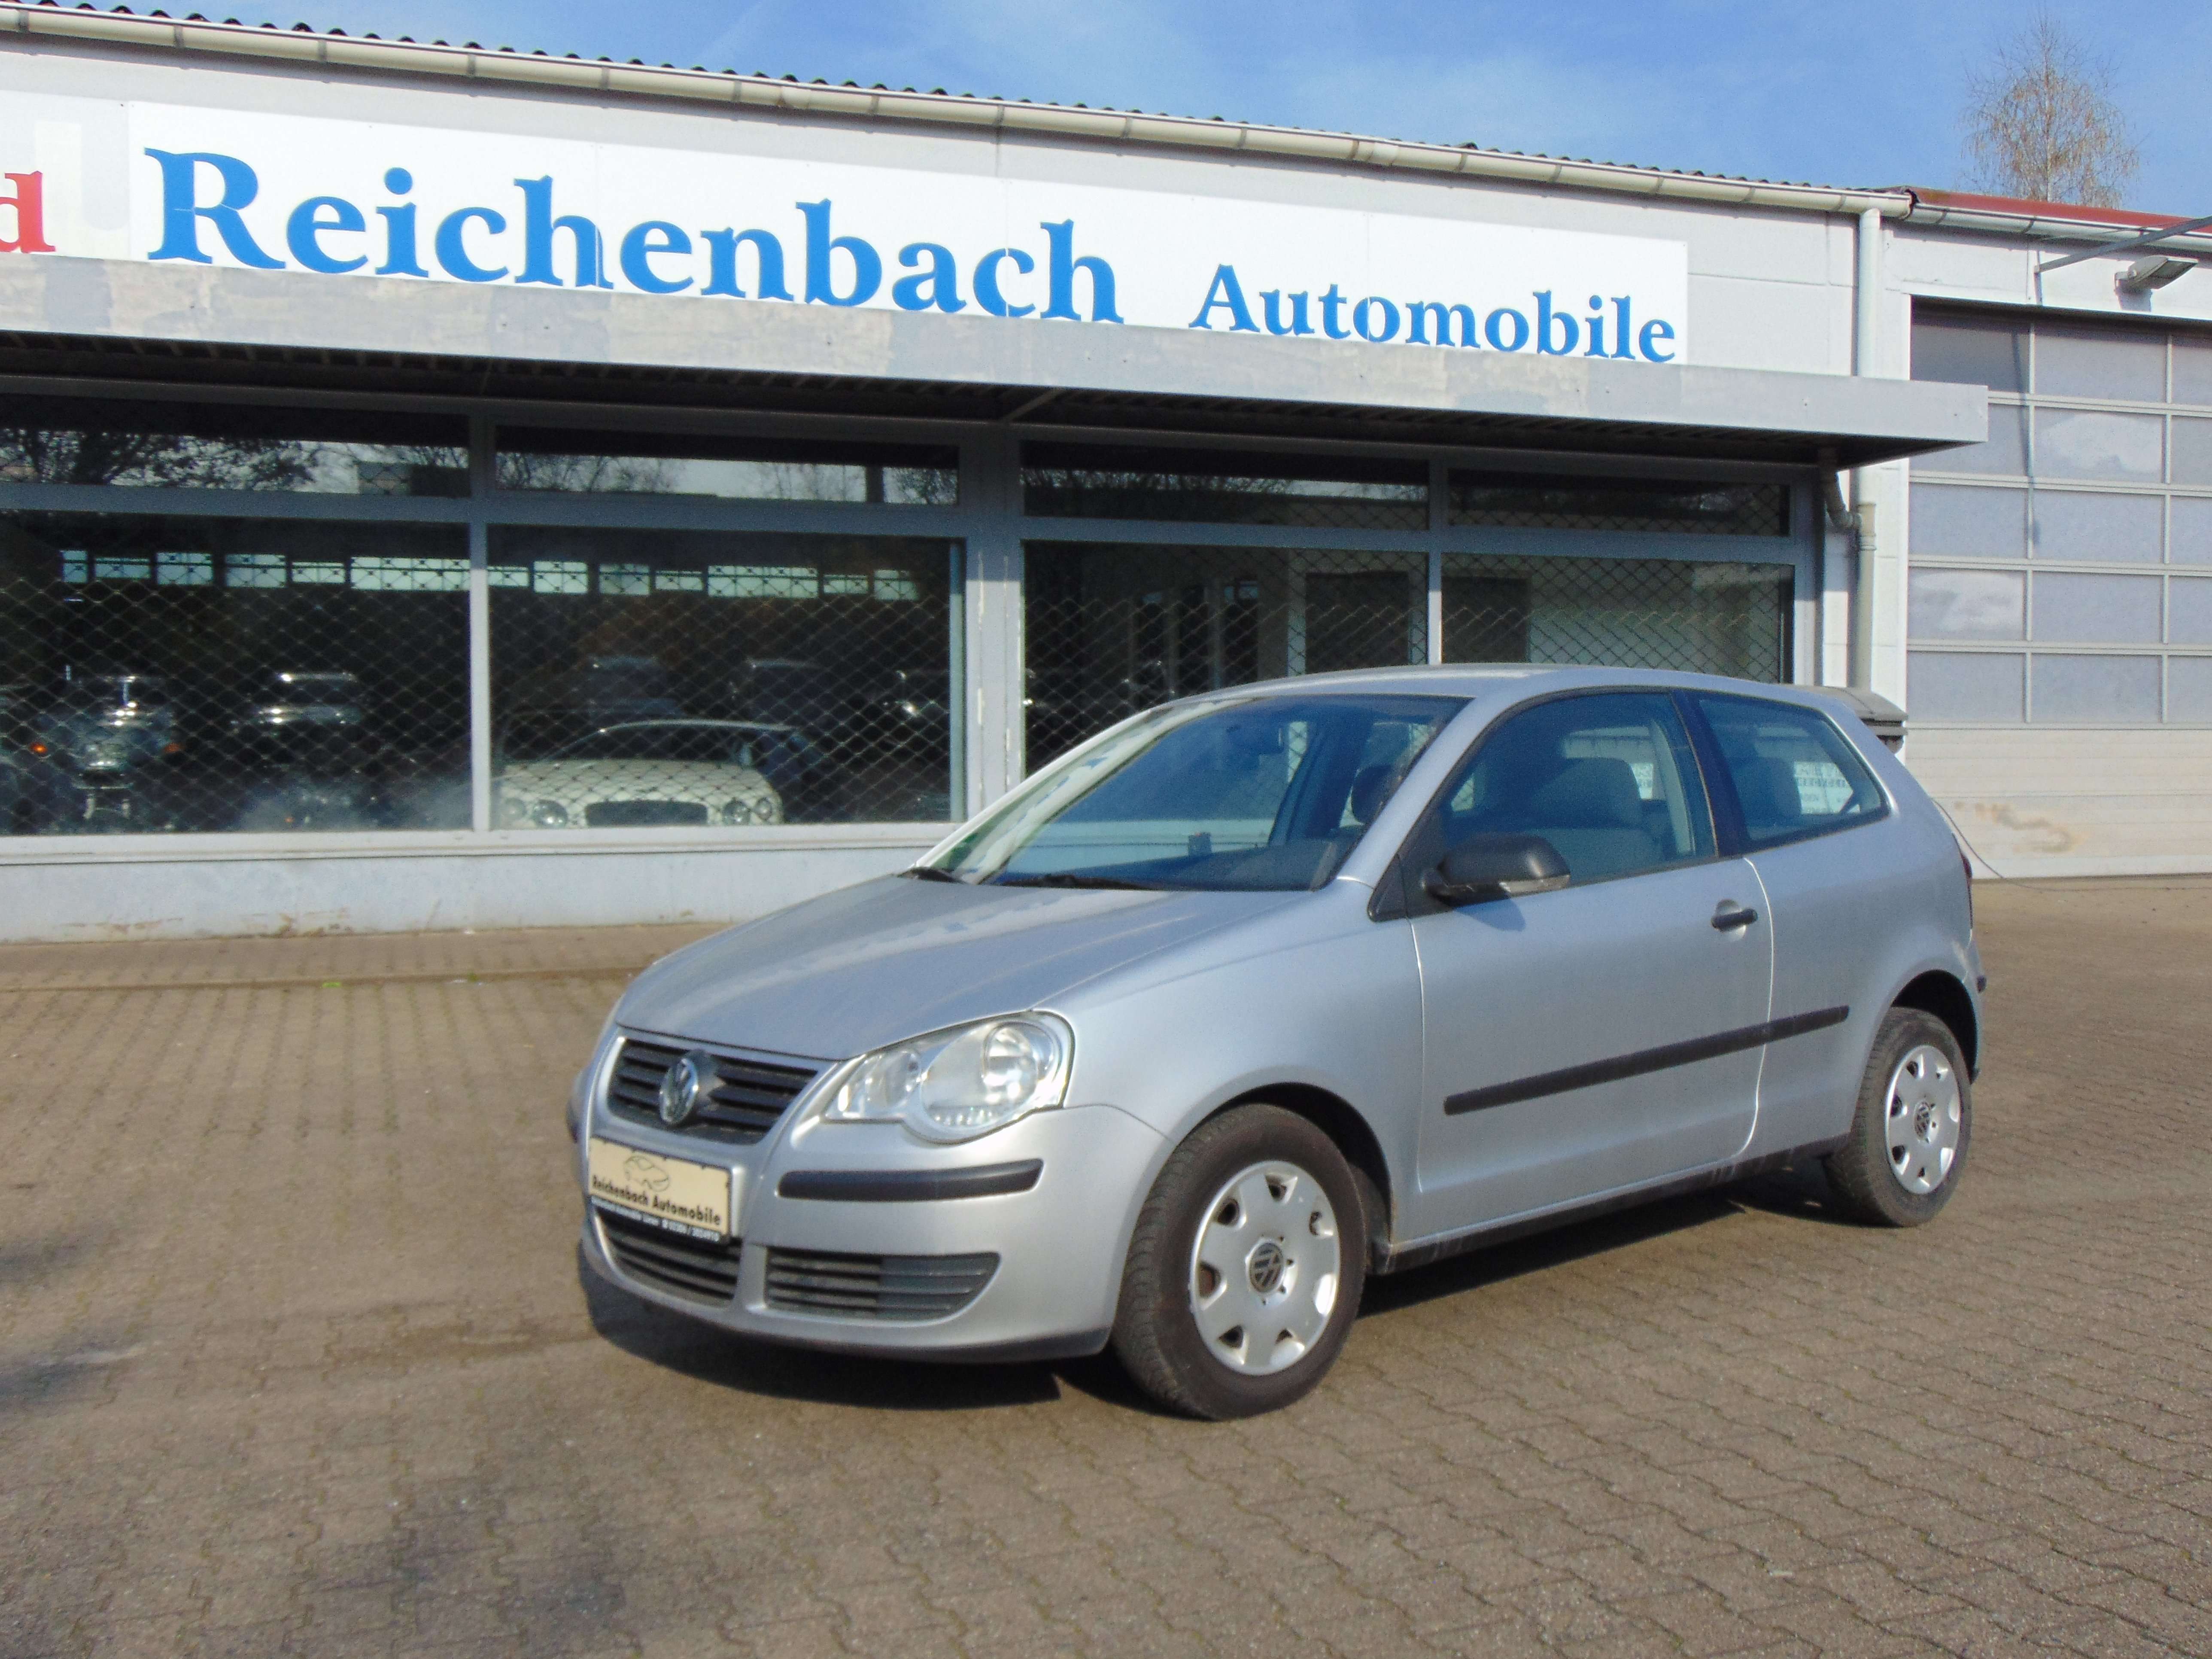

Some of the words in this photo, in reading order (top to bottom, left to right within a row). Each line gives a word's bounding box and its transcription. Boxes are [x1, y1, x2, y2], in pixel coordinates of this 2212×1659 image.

[144, 148, 1124, 324] Reichenbach
[1188, 264, 1676, 363] Automobile
[592, 1175, 648, 1206] Reichenbach
[653, 1195, 720, 1225] Automobile
